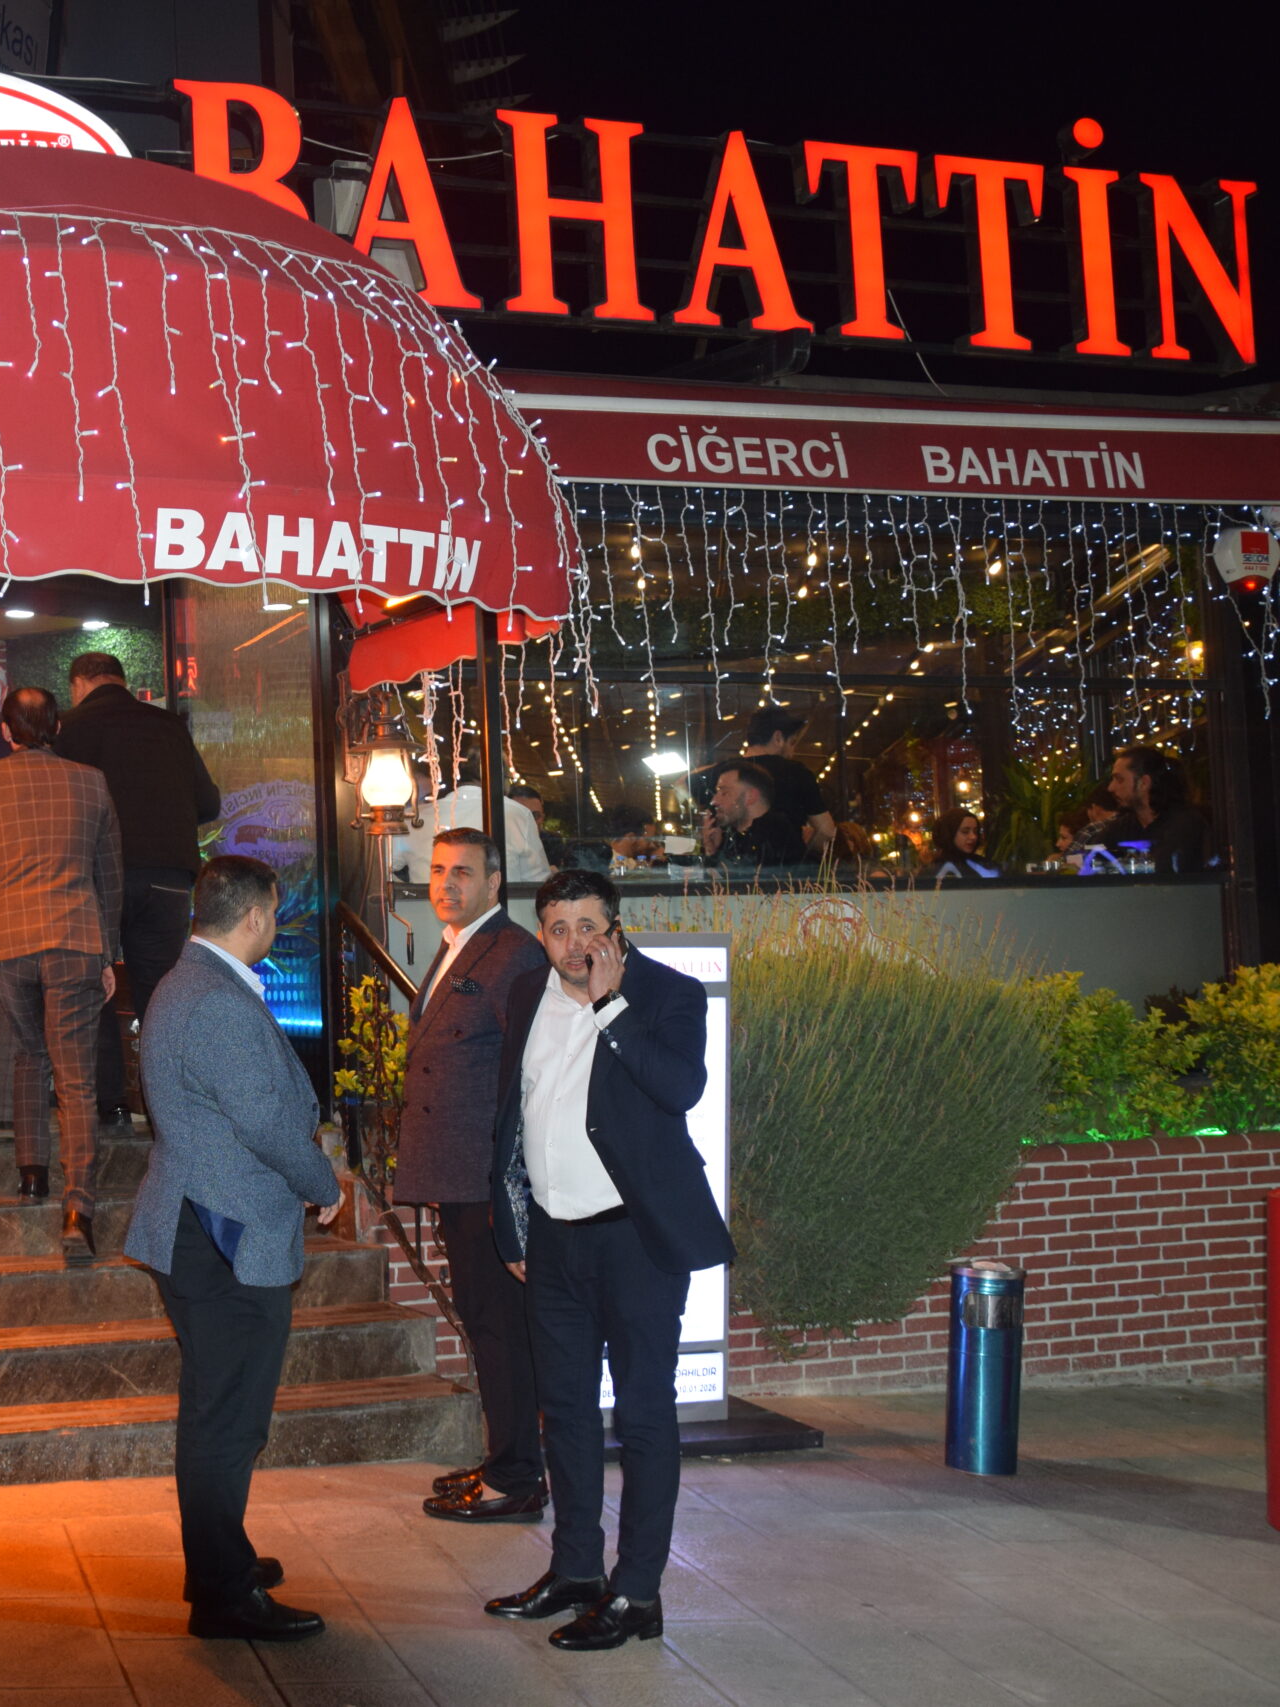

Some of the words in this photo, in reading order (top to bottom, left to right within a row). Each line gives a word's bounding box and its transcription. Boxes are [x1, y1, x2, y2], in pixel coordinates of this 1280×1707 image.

[173, 79, 1257, 366] BAHATTİN
[647, 425, 850, 479] CİĞERCİ
[923, 440, 1146, 490] BAHATTİN
[154, 507, 483, 594] BAHATTİN
